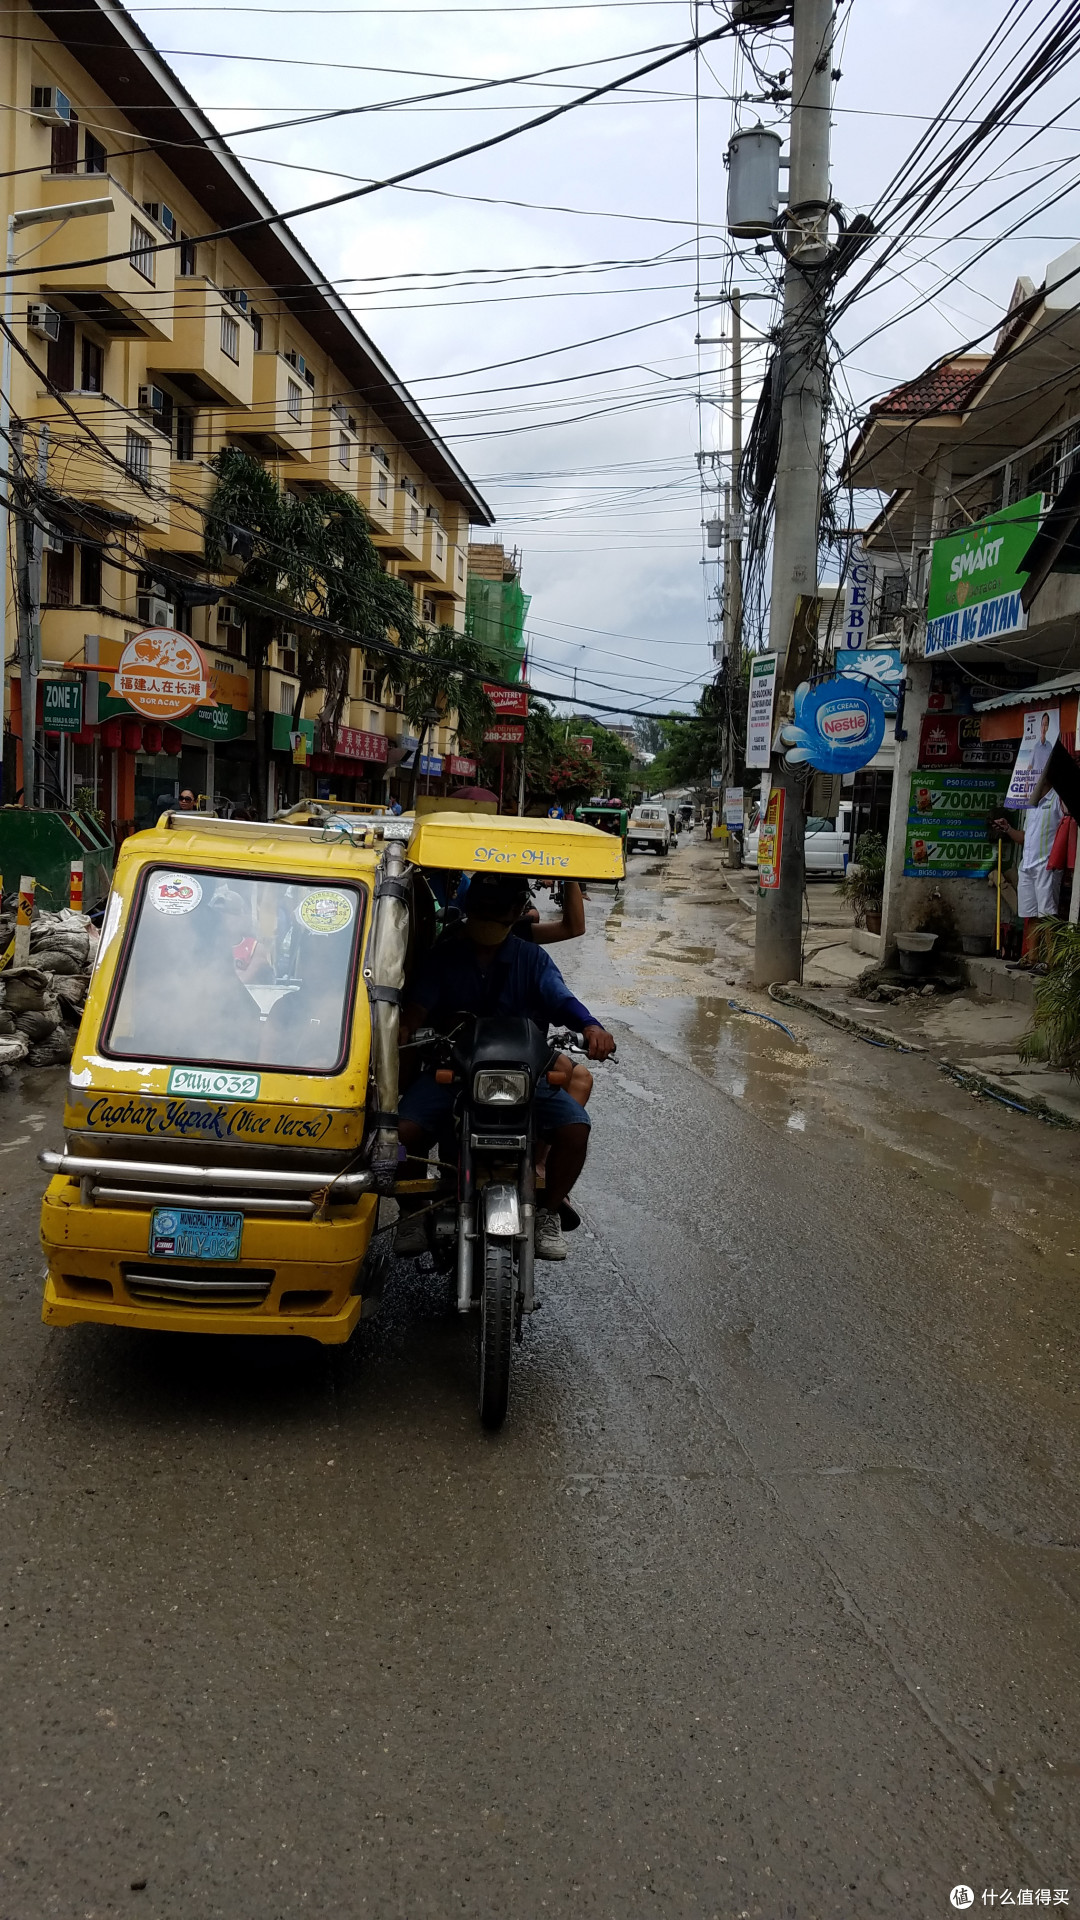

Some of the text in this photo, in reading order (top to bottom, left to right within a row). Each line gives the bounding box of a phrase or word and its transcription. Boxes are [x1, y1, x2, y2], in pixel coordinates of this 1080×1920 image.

[950, 537, 1005, 582] SMART
[846, 565, 869, 650] CEBU
[926, 593, 1021, 654] BOTIKA NG BAYAN
[120, 677, 201, 696] 福建人在长滩
[488, 691, 523, 699] MONTEREY
[46, 685, 79, 709] ZONE 7
[140, 697, 181, 707] BORACAY
[484, 732, 523, 741] 288-2357
[344, 746, 379, 759] MASARAP
[928, 743, 947, 754] TM
[941, 792, 998, 809] 700MB
[473, 847, 570, 868] For Hire
[937, 843, 993, 860] 700MB
[213, 1075, 256, 1094] 032
[159, 1101, 228, 1138] Yapak
[227, 1106, 272, 1136] (Vice
[274, 1112, 333, 1144] Versa)
[180, 1212, 240, 1228] MUNICIPALITY OF MALAY
[176, 1235, 237, 1257] MLY-032
